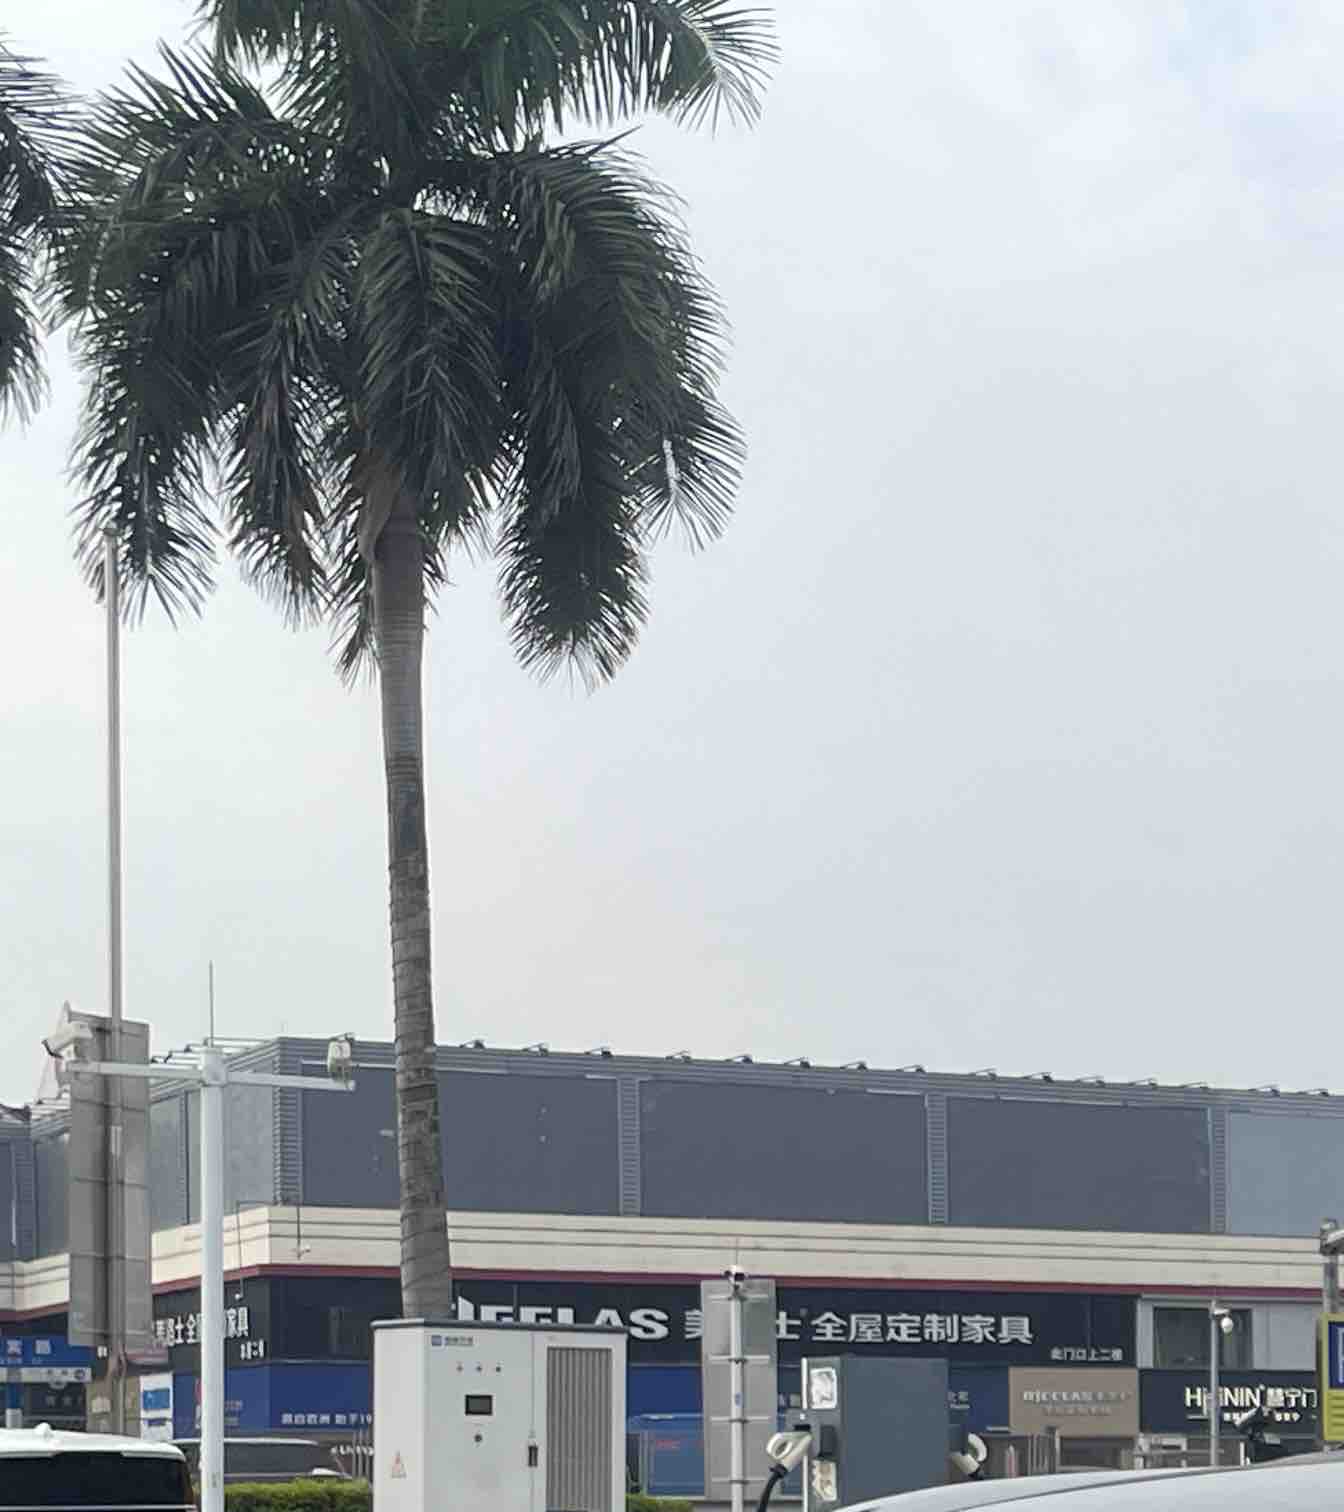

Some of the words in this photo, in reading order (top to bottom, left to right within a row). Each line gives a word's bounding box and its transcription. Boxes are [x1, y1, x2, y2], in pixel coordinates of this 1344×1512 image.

[811, 1311, 1033, 1345] 全屋定制家具
